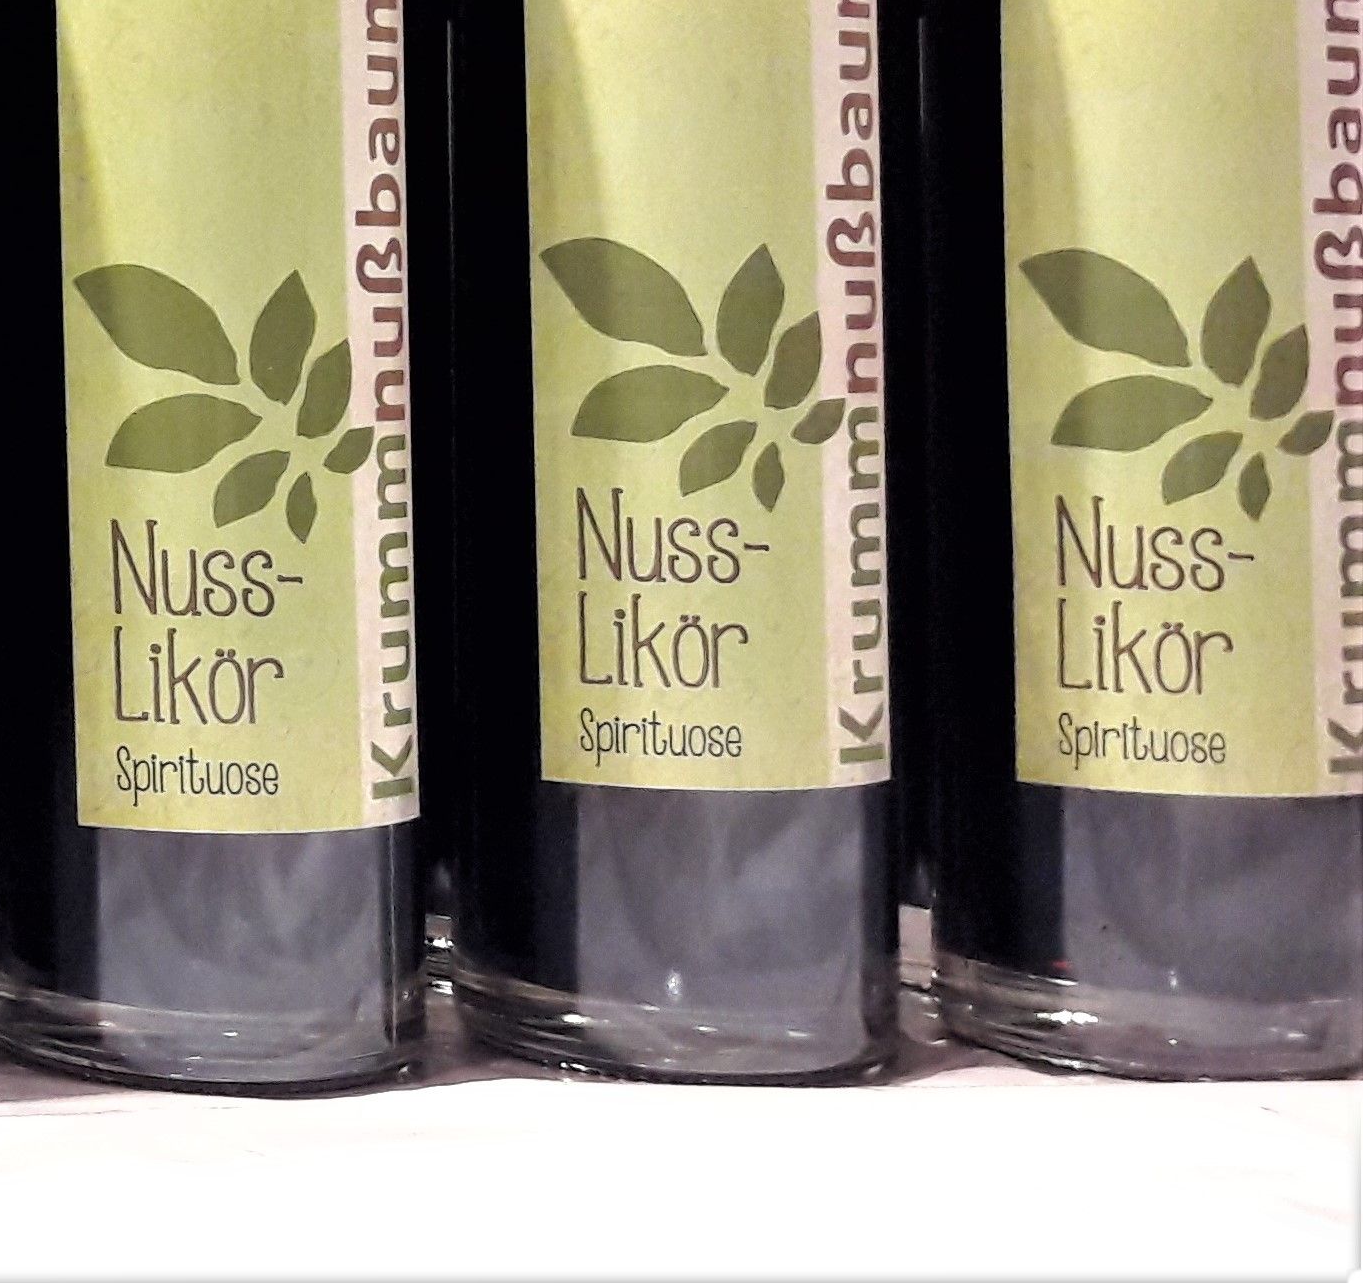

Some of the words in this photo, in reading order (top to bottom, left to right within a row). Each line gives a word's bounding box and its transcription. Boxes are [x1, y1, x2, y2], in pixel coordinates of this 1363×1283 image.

[110, 519, 303, 617] Nuss-
[575, 487, 770, 584] Nuss-
[1055, 496, 1254, 592] Nuss-
[114, 626, 284, 725] Likör
[578, 591, 749, 688] Likör
[1057, 598, 1233, 695] Likör
[116, 746, 279, 807] Spirituose
[580, 707, 742, 767] Spirituose
[1058, 712, 1226, 770] Spirituose
